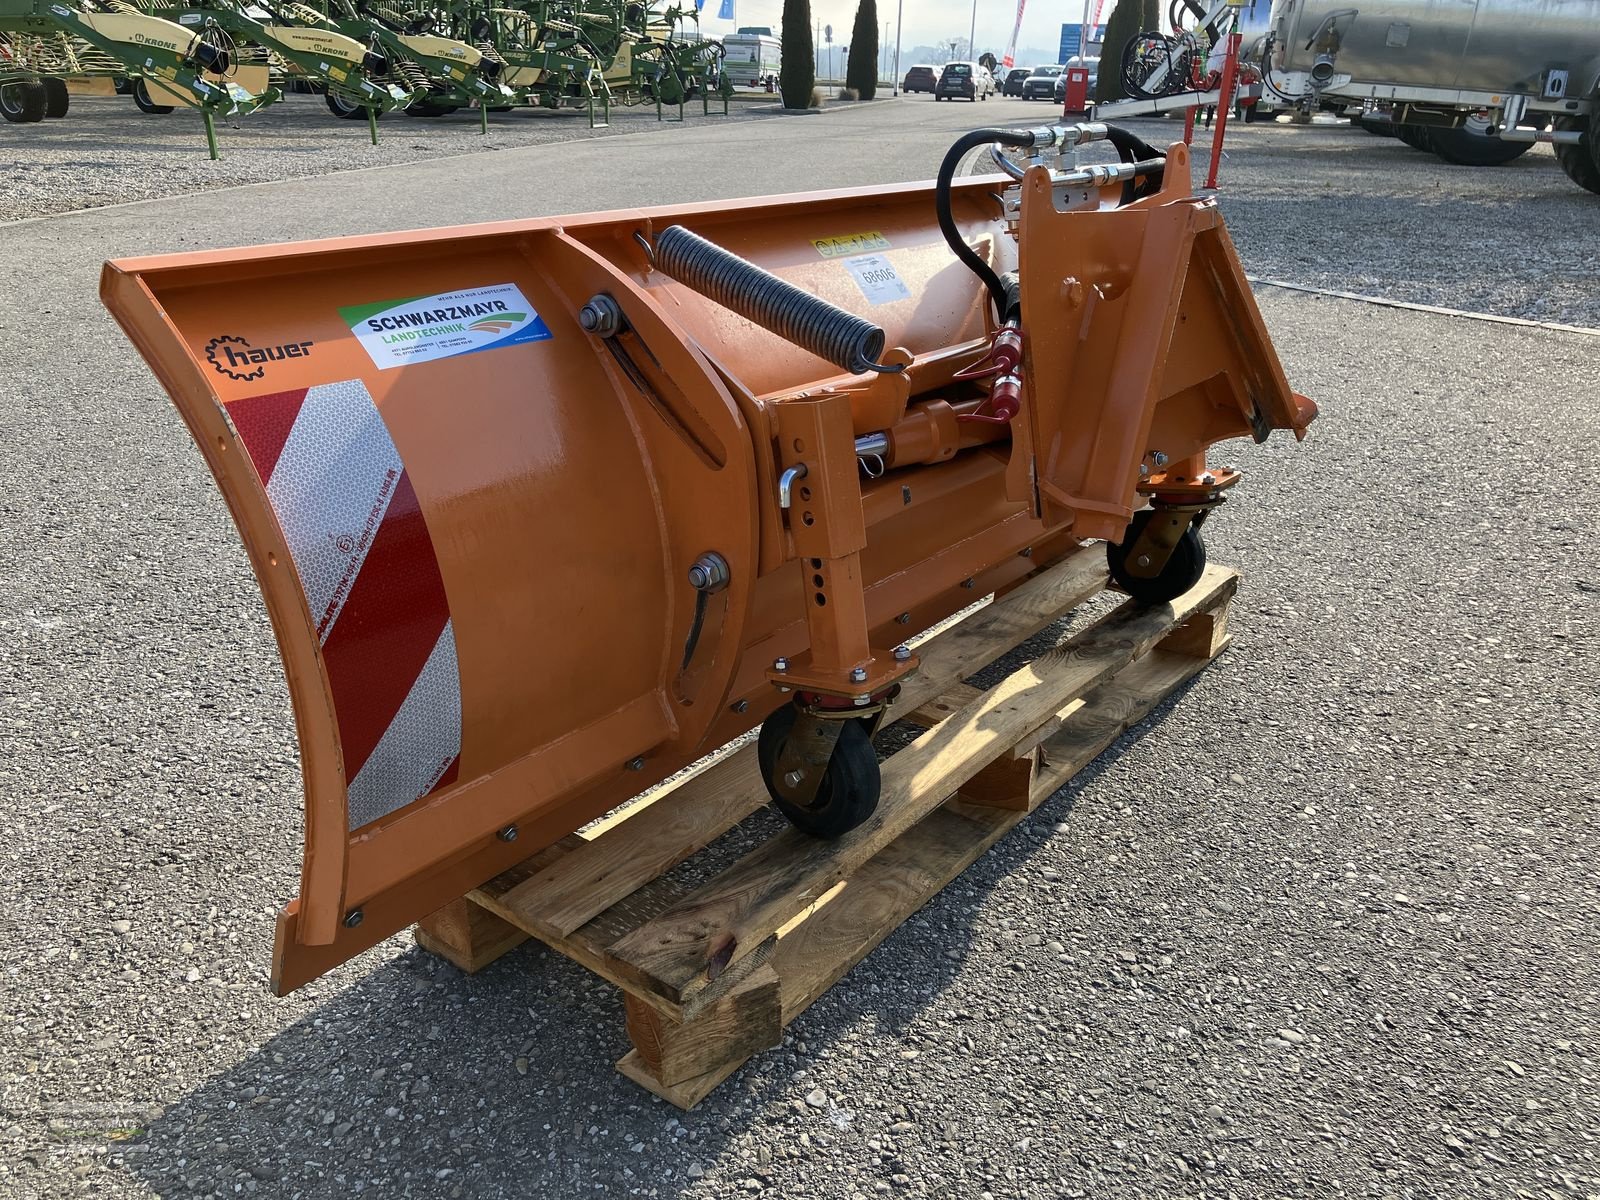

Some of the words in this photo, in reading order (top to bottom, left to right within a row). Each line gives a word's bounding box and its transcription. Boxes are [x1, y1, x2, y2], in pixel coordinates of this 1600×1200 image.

[144, 37, 177, 49] KRONE
[322, 47, 349, 57] KRONE
[444, 52, 467, 60] KRONE
[862, 267, 896, 284] 68606
[367, 300, 509, 332] SCHWARZMAYR
[381, 323, 467, 344] LANDTECHNIK
[223, 341, 314, 367] hauer
